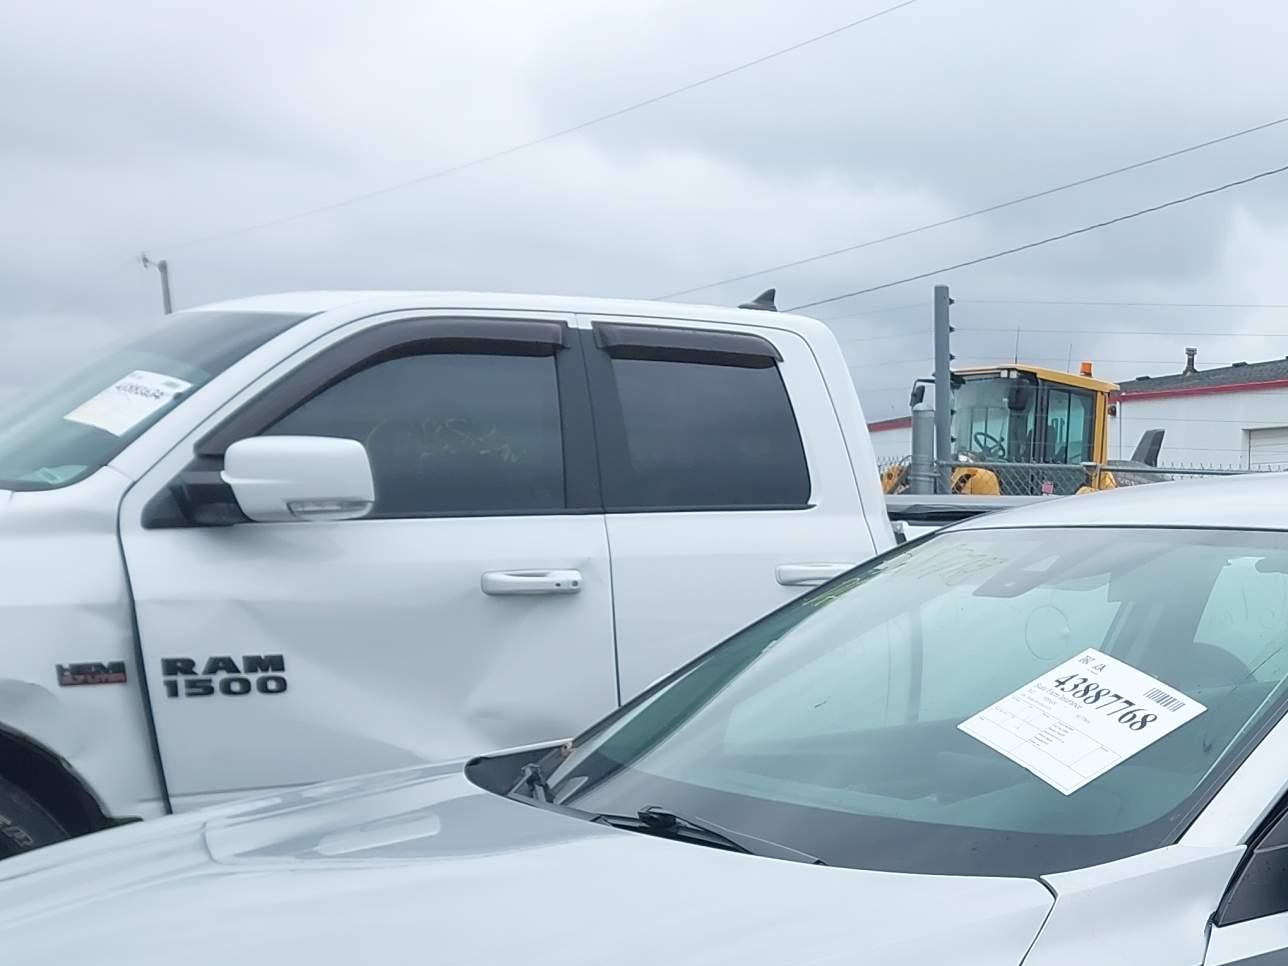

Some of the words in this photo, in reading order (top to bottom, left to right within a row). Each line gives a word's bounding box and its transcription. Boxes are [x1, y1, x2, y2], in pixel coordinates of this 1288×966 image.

[161, 654, 286, 676] RAM
[164, 675, 288, 698] 1500
[1053, 673, 1158, 731] 43887768
